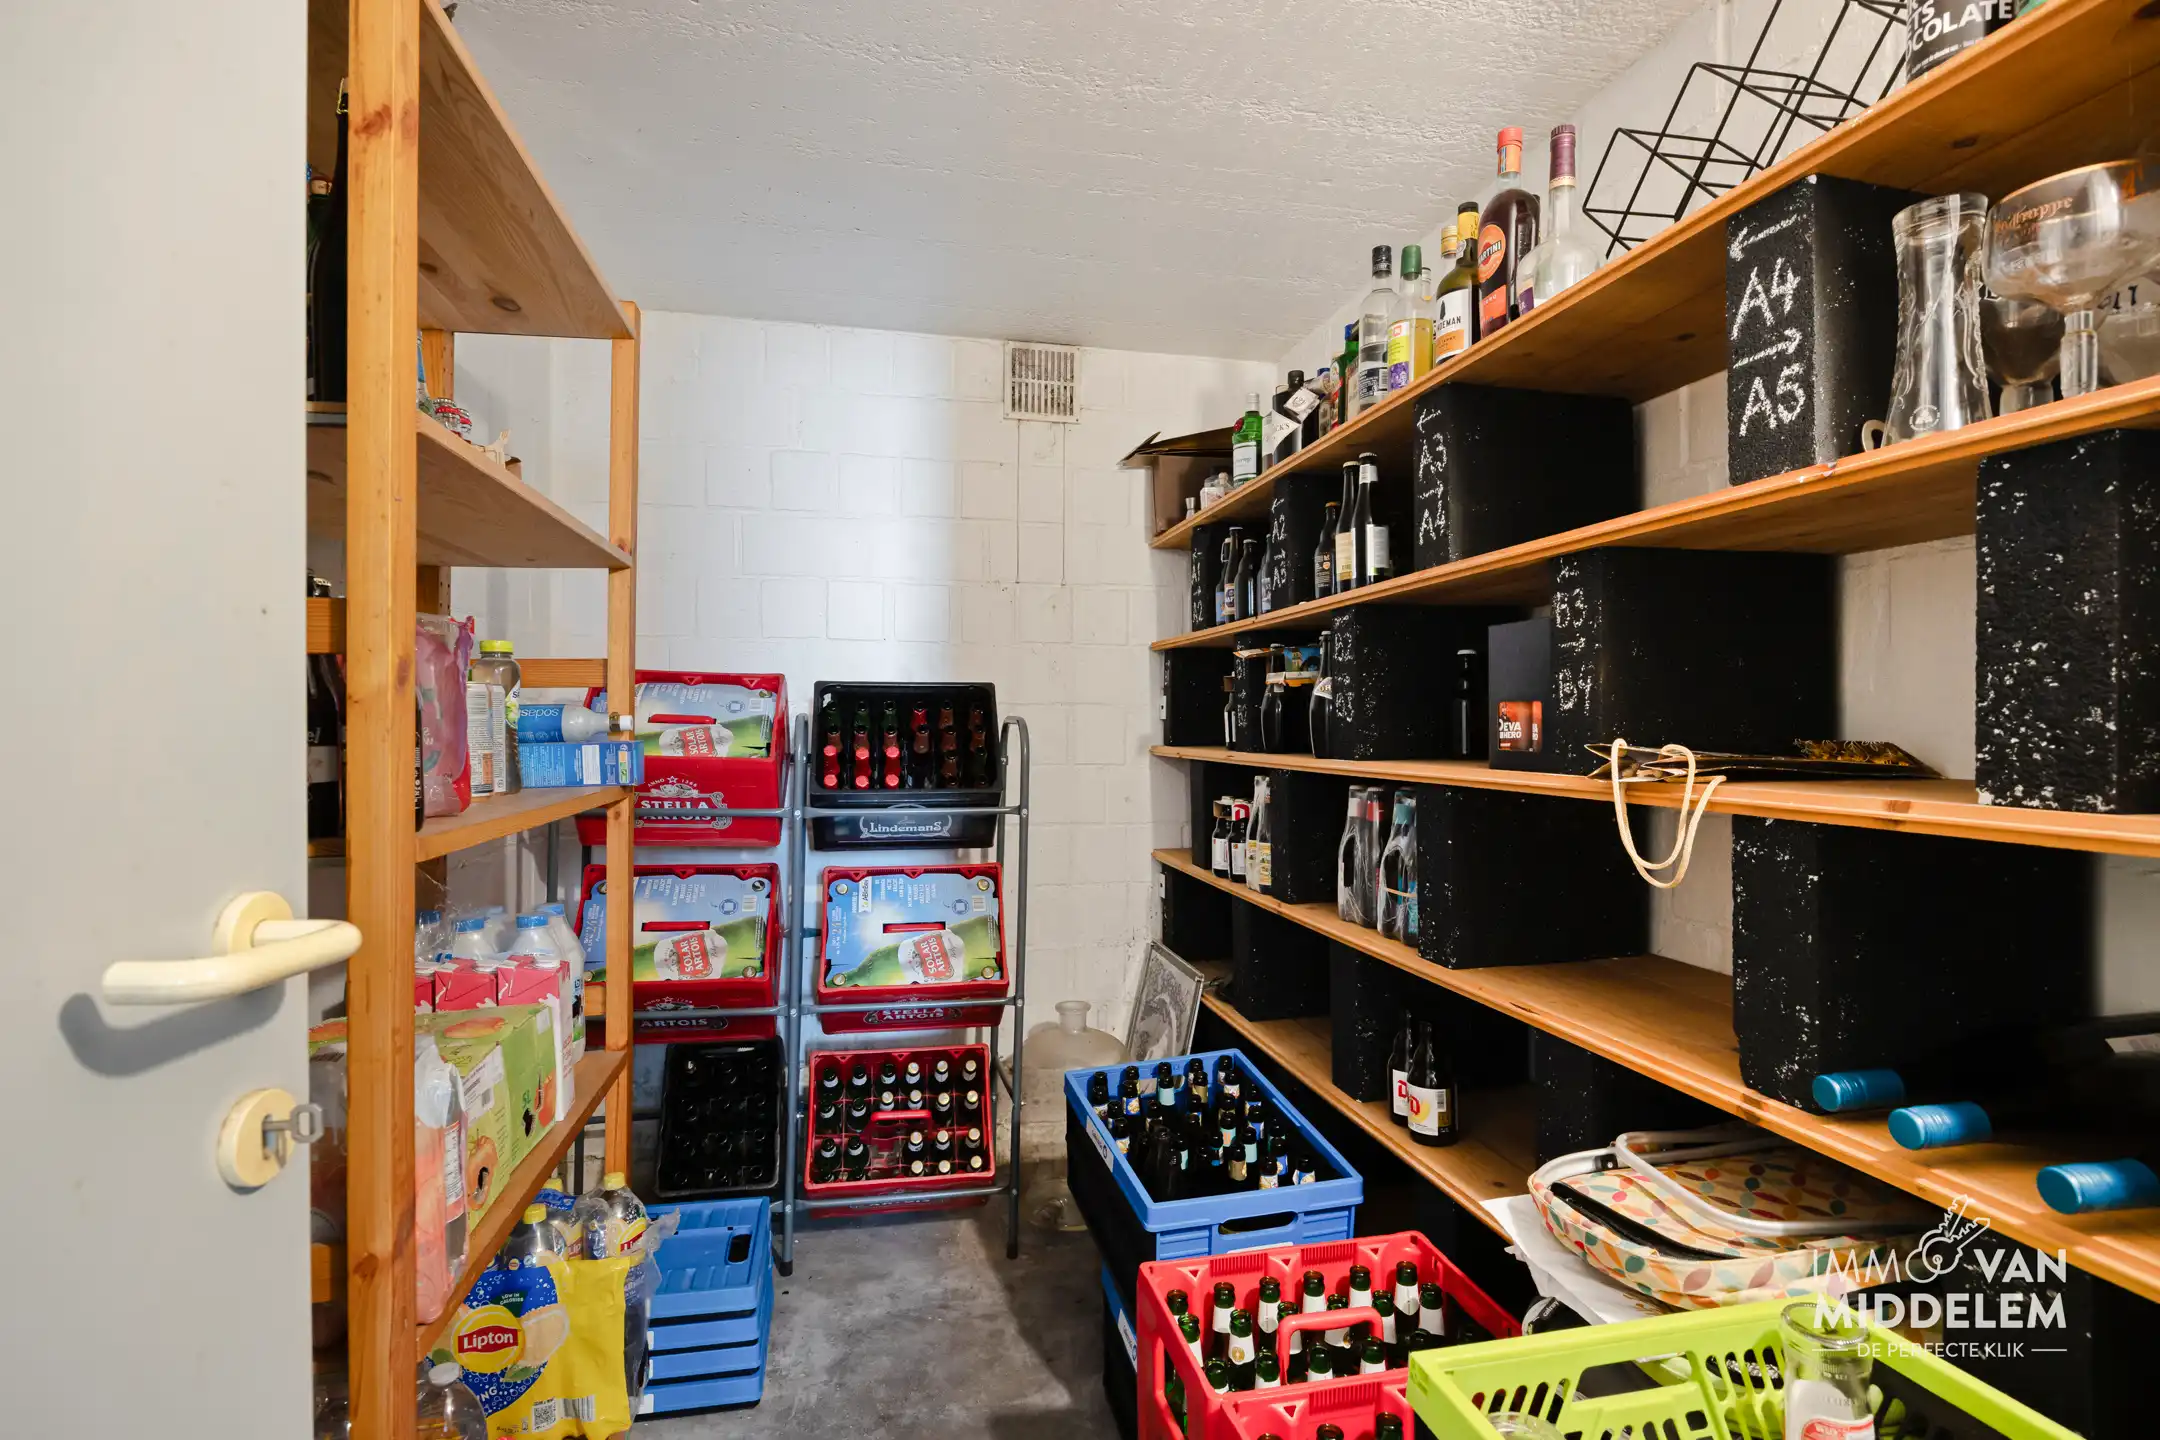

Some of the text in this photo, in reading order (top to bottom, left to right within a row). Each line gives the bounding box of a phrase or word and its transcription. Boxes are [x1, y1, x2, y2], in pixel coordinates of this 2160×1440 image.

[1731, 257, 1801, 340] A4
[1739, 363, 1805, 436] A5
[1419, 500, 1446, 545] A4
[686, 731, 699, 756] SOLAR
[680, 940, 694, 972] SOLAR
[688, 936, 705, 971] ARTOIS
[920, 941, 936, 975] SOLAR
[929, 937, 946, 972] ARTOIS
[641, 1018, 707, 1028] ARTOIS
[463, 1332, 514, 1350] Lipton
